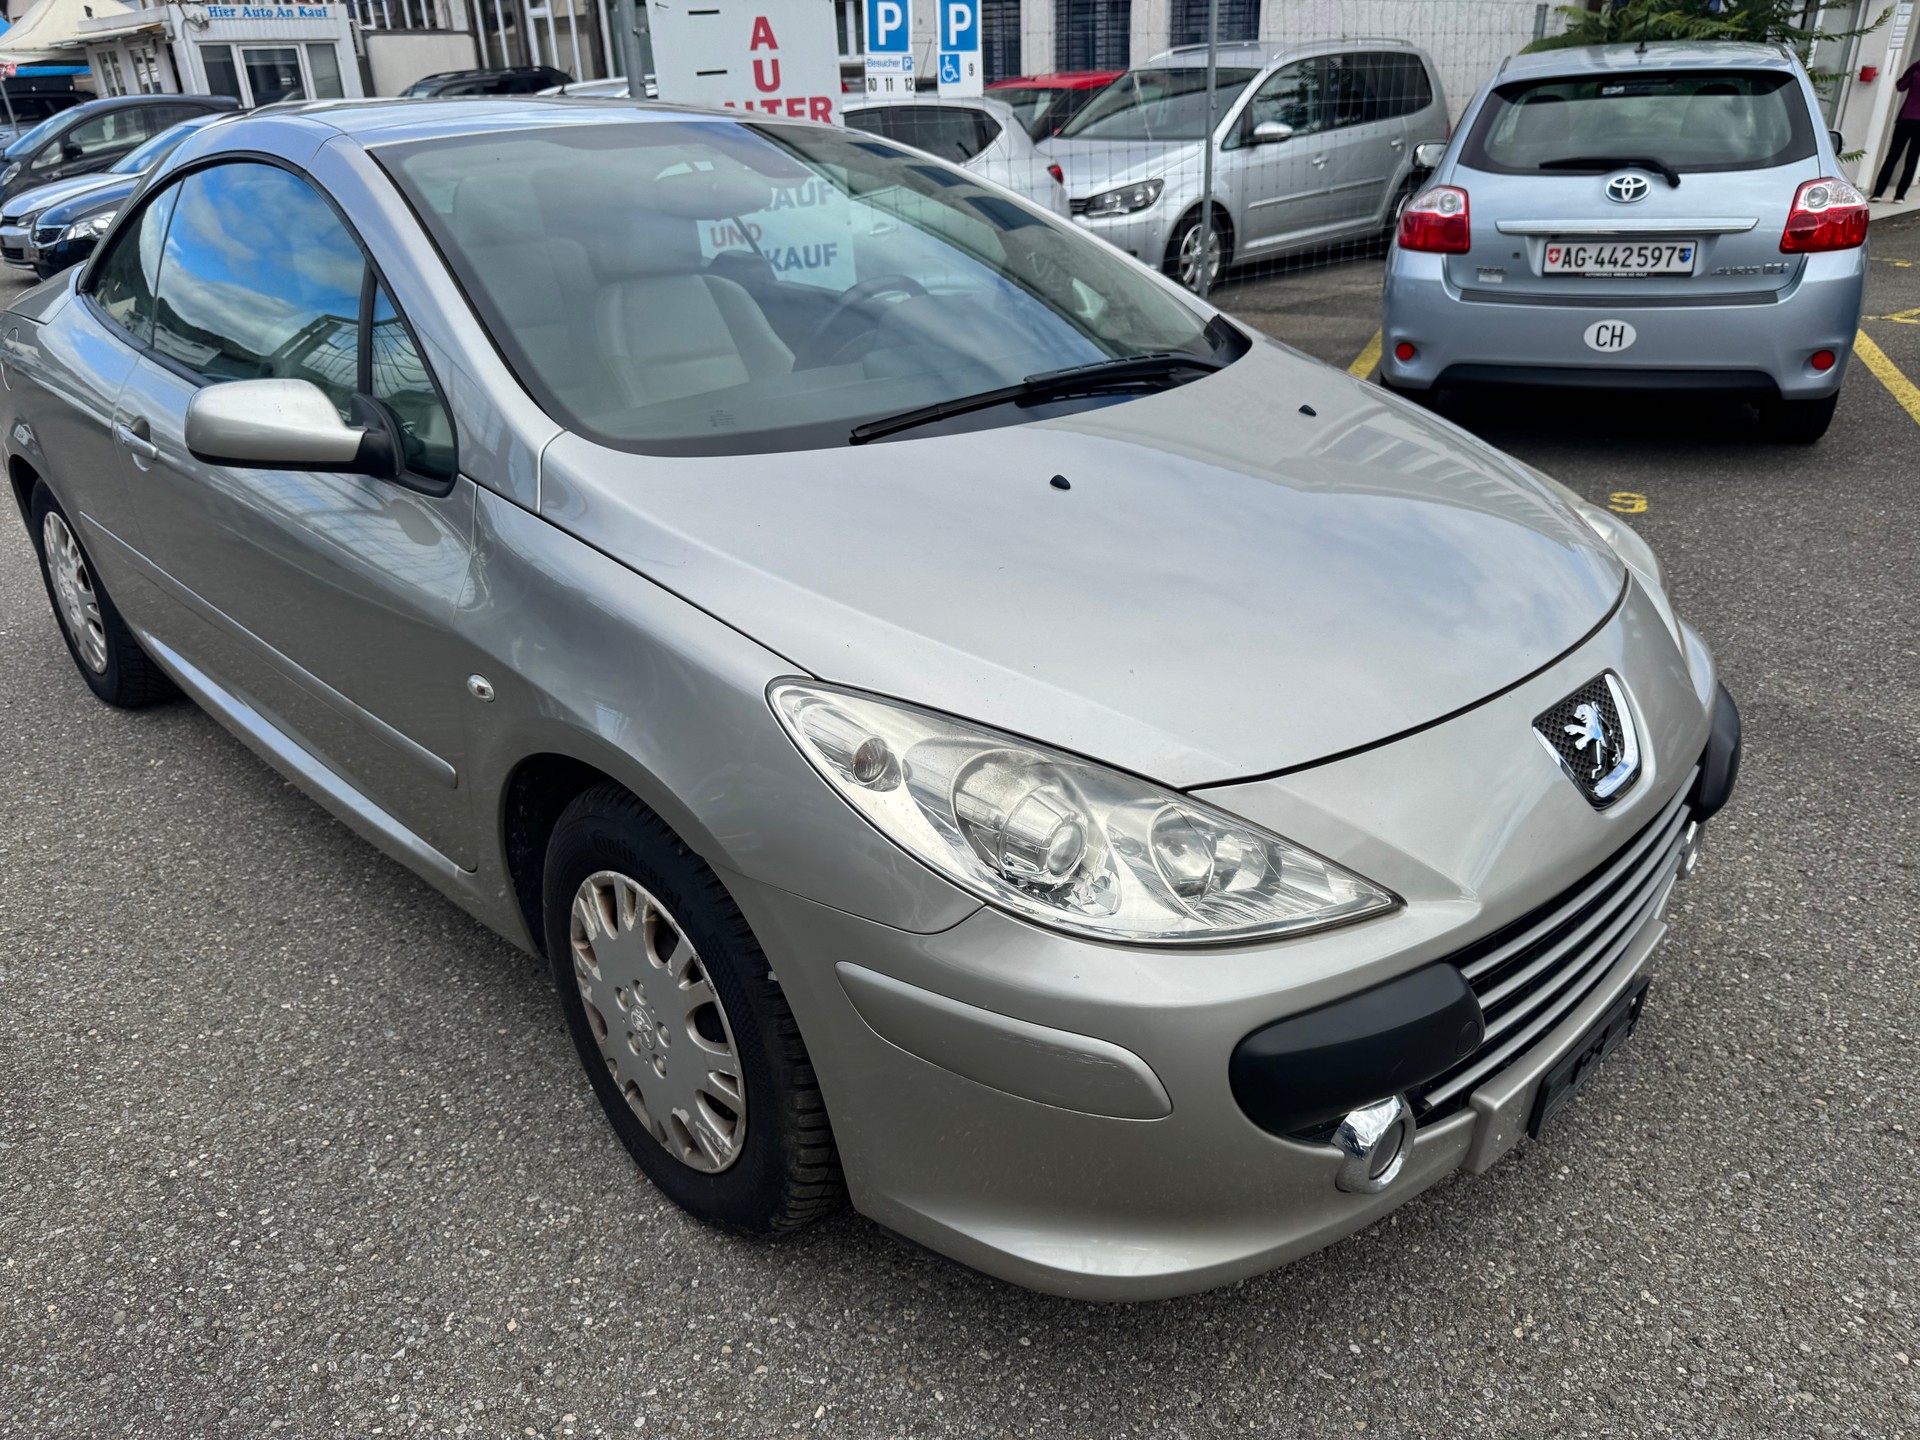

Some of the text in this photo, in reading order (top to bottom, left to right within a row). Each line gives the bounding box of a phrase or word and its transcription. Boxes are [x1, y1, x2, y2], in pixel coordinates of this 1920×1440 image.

[208, 6, 327, 18] Hier Auto An Kauf
[877, 2, 902, 45] P
[948, 3, 972, 45] P
[867, 58, 900, 68] Besucher
[968, 62, 975, 77] 9
[868, 77, 914, 92] 10 11 12
[765, 181, 834, 212] AUF
[710, 223, 762, 249] UND
[1596, 324, 1624, 347] CH
